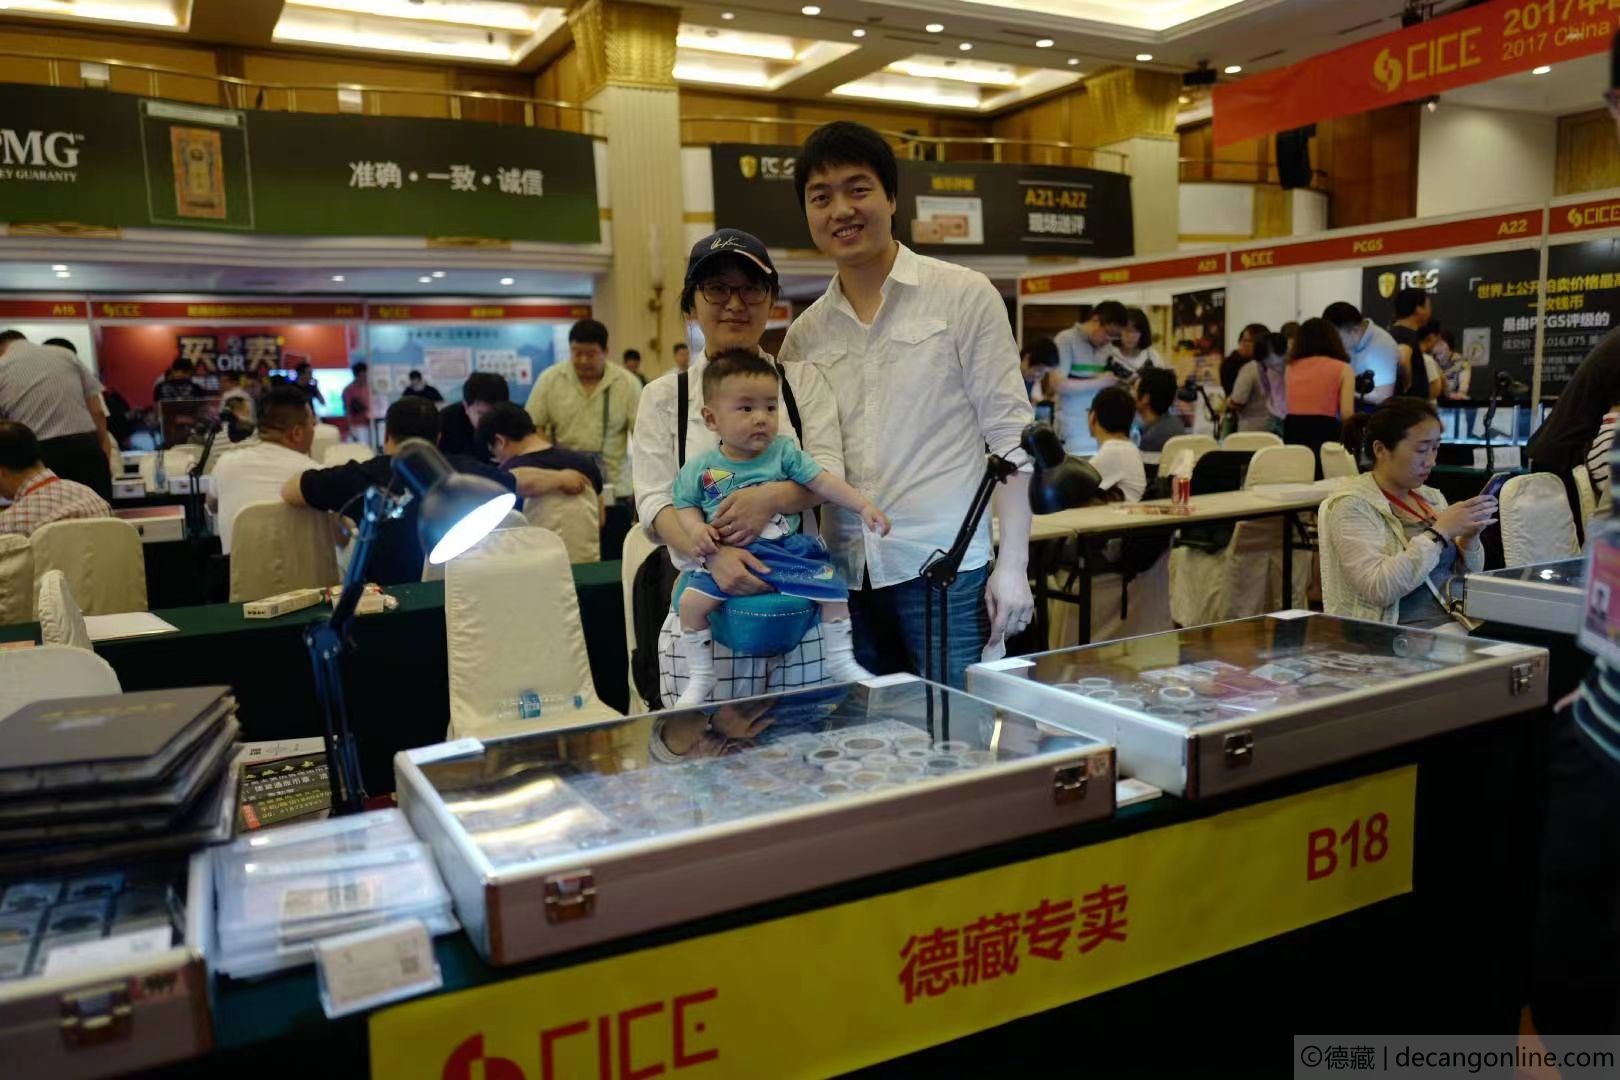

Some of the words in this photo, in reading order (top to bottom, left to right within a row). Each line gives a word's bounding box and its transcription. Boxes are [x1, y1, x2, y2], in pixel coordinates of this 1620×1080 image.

[1406, 26, 1483, 82] CICE
[1503, 33, 1548, 61] 2017
[1554, 21, 1610, 47] China
[0, 129, 79, 168] MG
[16, 170, 77, 182] GUARANTY
[1353, 239, 1383, 253] PCGS
[1498, 219, 1528, 236] A22
[217, 354, 245, 372] OR
[1307, 812, 1390, 882] B18
[898, 883, 1129, 1005] 德藏专卖
